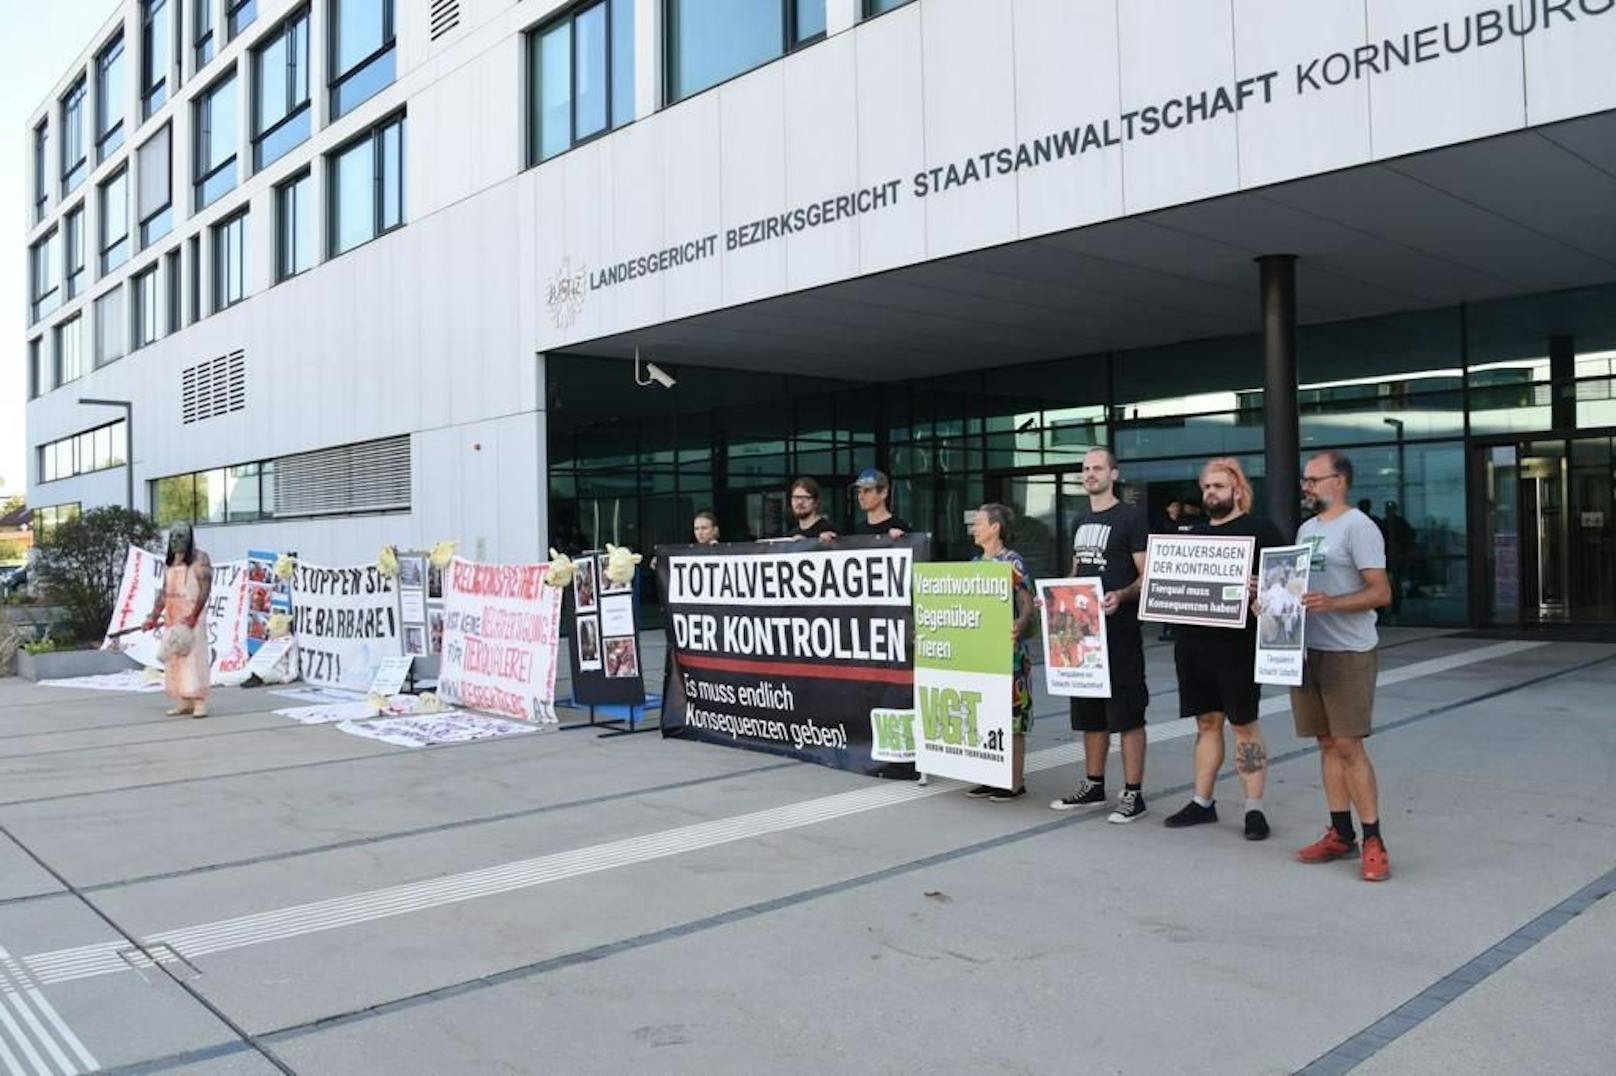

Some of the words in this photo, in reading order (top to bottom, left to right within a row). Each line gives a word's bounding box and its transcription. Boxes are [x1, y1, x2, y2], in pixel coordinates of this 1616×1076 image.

[590, 234, 717, 290] LANDESGERICHT
[726, 179, 902, 251] BEZIRKSGERICHT
[914, 71, 1279, 197] STAATSANWALTSCHAFT
[1156, 544, 1245, 559] TOTALVERSAGEN
[292, 563, 362, 596] STOPPEN
[673, 556, 907, 599] TOTALVERSAGEN
[1153, 561, 1172, 574] DER
[1175, 561, 1243, 576] KONTROLLEN
[914, 572, 1008, 601] Verantwortung
[1186, 587, 1210, 596] muss
[915, 603, 981, 632] Gegenüber
[1148, 598, 1209, 612] Konsequenzen
[673, 613, 718, 652] DER
[723, 614, 907, 662] KONTROLLEN
[916, 634, 951, 659] Tieren
[297, 647, 341, 682] ETZT!
[684, 672, 698, 699] Es
[699, 681, 736, 705] muss
[737, 681, 795, 712] endlich
[685, 702, 789, 741] Konsequenzen
[790, 719, 848, 750] geben!
